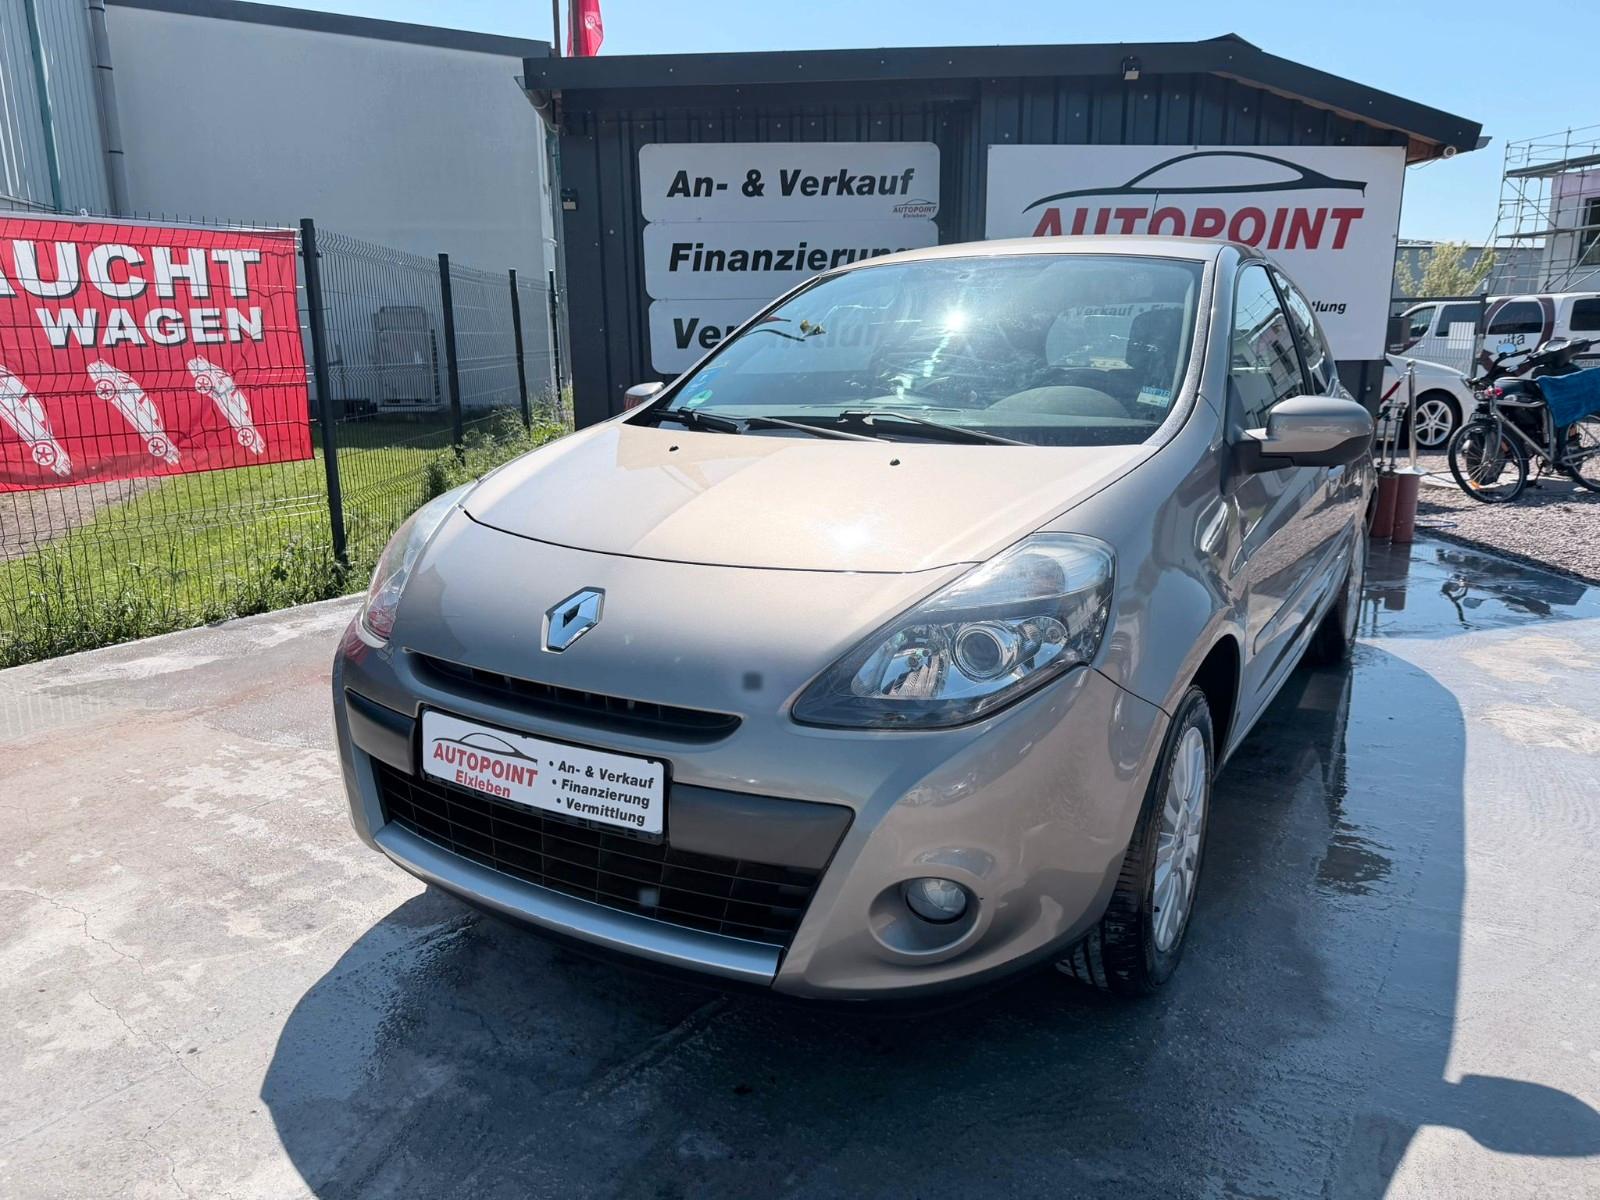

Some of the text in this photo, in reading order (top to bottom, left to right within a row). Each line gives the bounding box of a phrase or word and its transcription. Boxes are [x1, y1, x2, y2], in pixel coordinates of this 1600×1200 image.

[667, 168, 915, 198] An- & Verkauf
[1032, 206, 1365, 250] AUTOPOINT
[1312, 301, 1347, 315] lung
[35, 305, 264, 348] WAGEN
[433, 742, 539, 788] AUTOPOINT
[557, 760, 655, 790] An- & Verkauf
[455, 768, 512, 799] Elxleben
[561, 778, 651, 810] Finanzierung
[566, 797, 646, 828] Vermittlung
